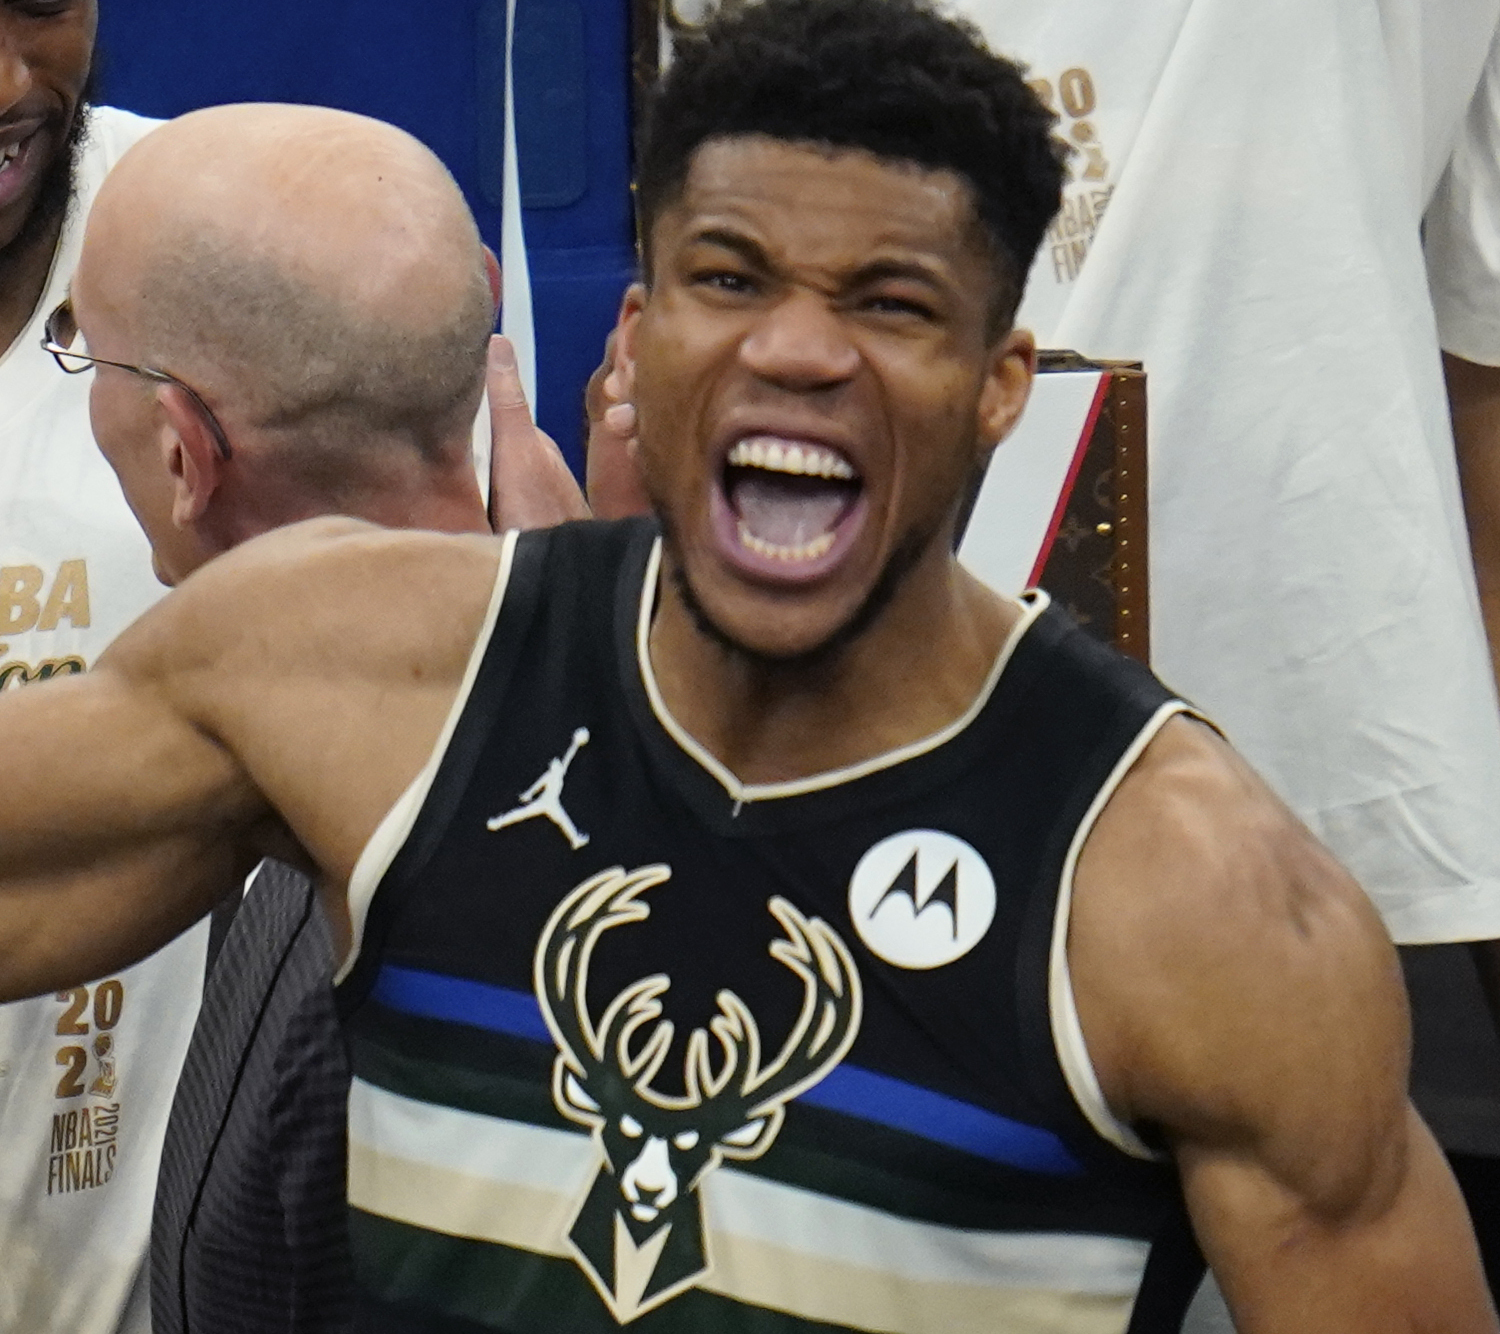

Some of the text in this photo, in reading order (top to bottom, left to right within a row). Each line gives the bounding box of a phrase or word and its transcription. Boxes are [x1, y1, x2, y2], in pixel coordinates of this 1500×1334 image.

[55, 979, 124, 1036] 20
[52, 1103, 121, 1153] NBA 2021
[47, 1147, 117, 1196] FINALS
